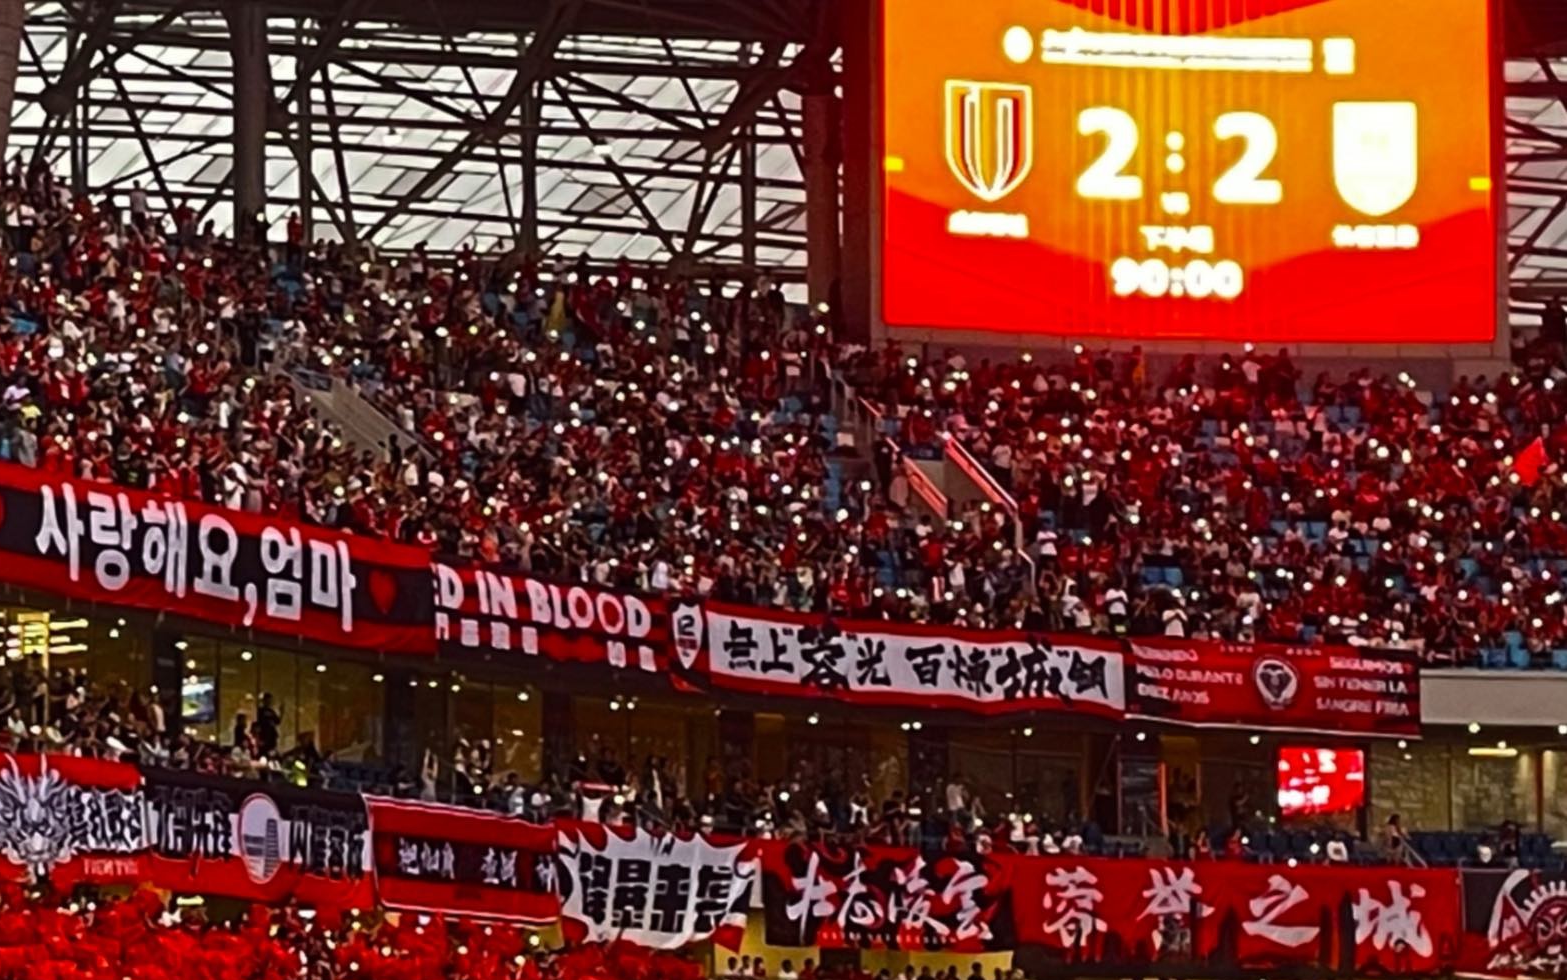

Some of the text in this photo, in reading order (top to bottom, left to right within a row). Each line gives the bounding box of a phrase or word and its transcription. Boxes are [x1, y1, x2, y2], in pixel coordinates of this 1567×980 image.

[1111, 257, 1243, 299] 90:00
[475, 570, 518, 620] IN
[524, 578, 652, 638] BLOOD
[1388, 679, 1409, 695] LA
